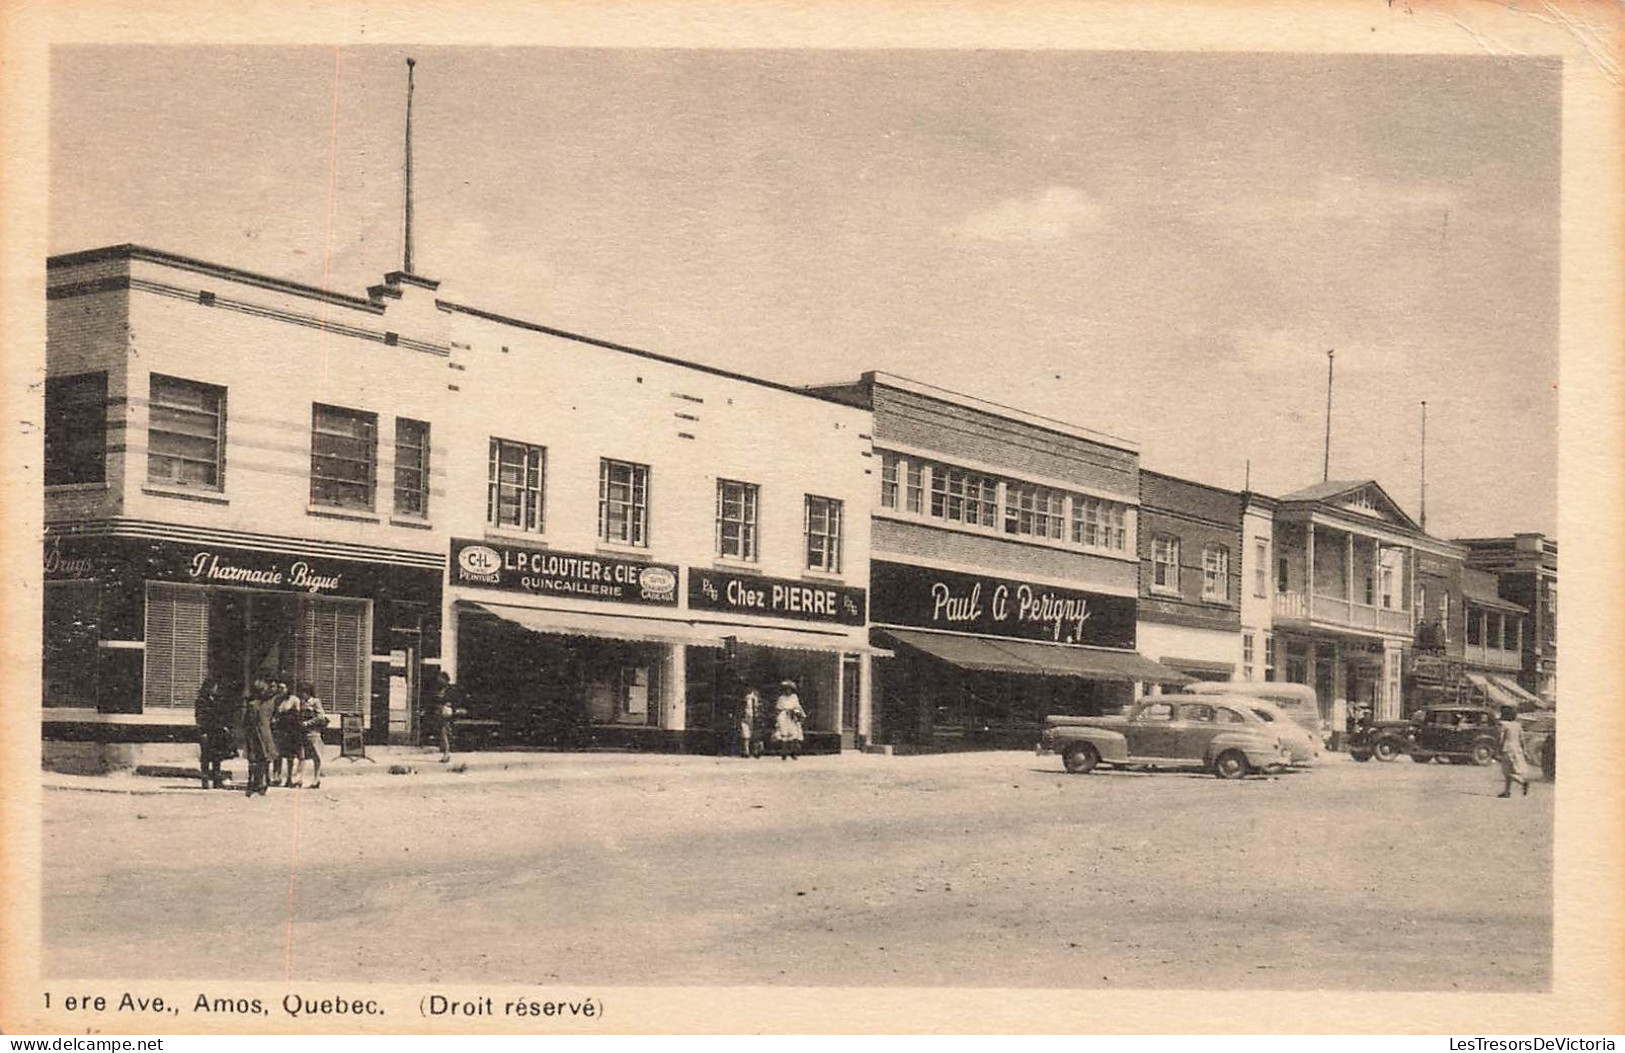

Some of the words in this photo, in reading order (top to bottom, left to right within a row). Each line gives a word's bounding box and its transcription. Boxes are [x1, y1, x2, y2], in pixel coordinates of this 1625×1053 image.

[288, 561, 341, 593] Bigué
[531, 553, 601, 581] CLOUTIER
[603, 566, 612, 581] &
[521, 576, 622, 597] QUINCAILLERIE
[727, 580, 765, 607] Chez
[772, 585, 837, 615] PIERRE
[932, 582, 981, 621] Paul
[992, 584, 1008, 621] A
[1017, 584, 1091, 640] Perigny
